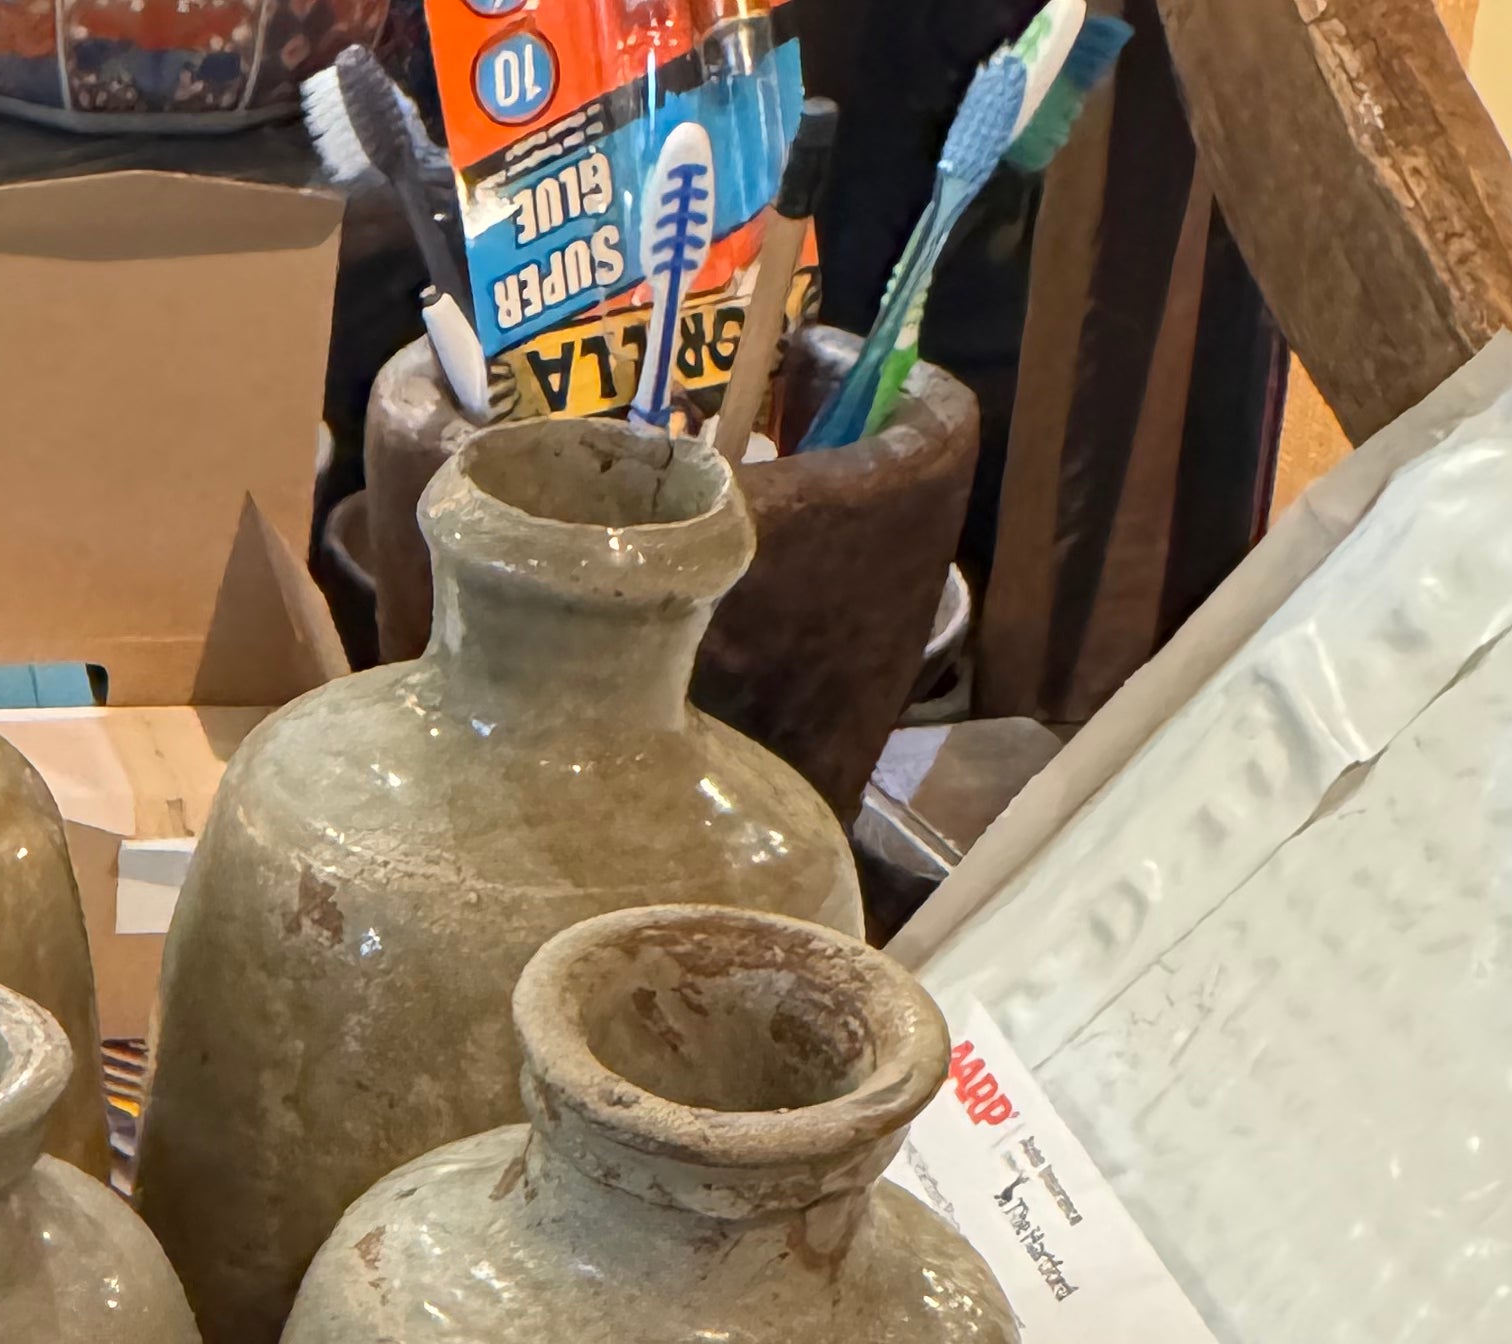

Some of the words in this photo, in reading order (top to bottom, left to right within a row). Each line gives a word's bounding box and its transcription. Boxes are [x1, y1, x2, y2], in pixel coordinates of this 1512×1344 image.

[494, 44, 542, 107] 10
[512, 153, 613, 244] GLUE
[493, 225, 624, 328] SUPER
